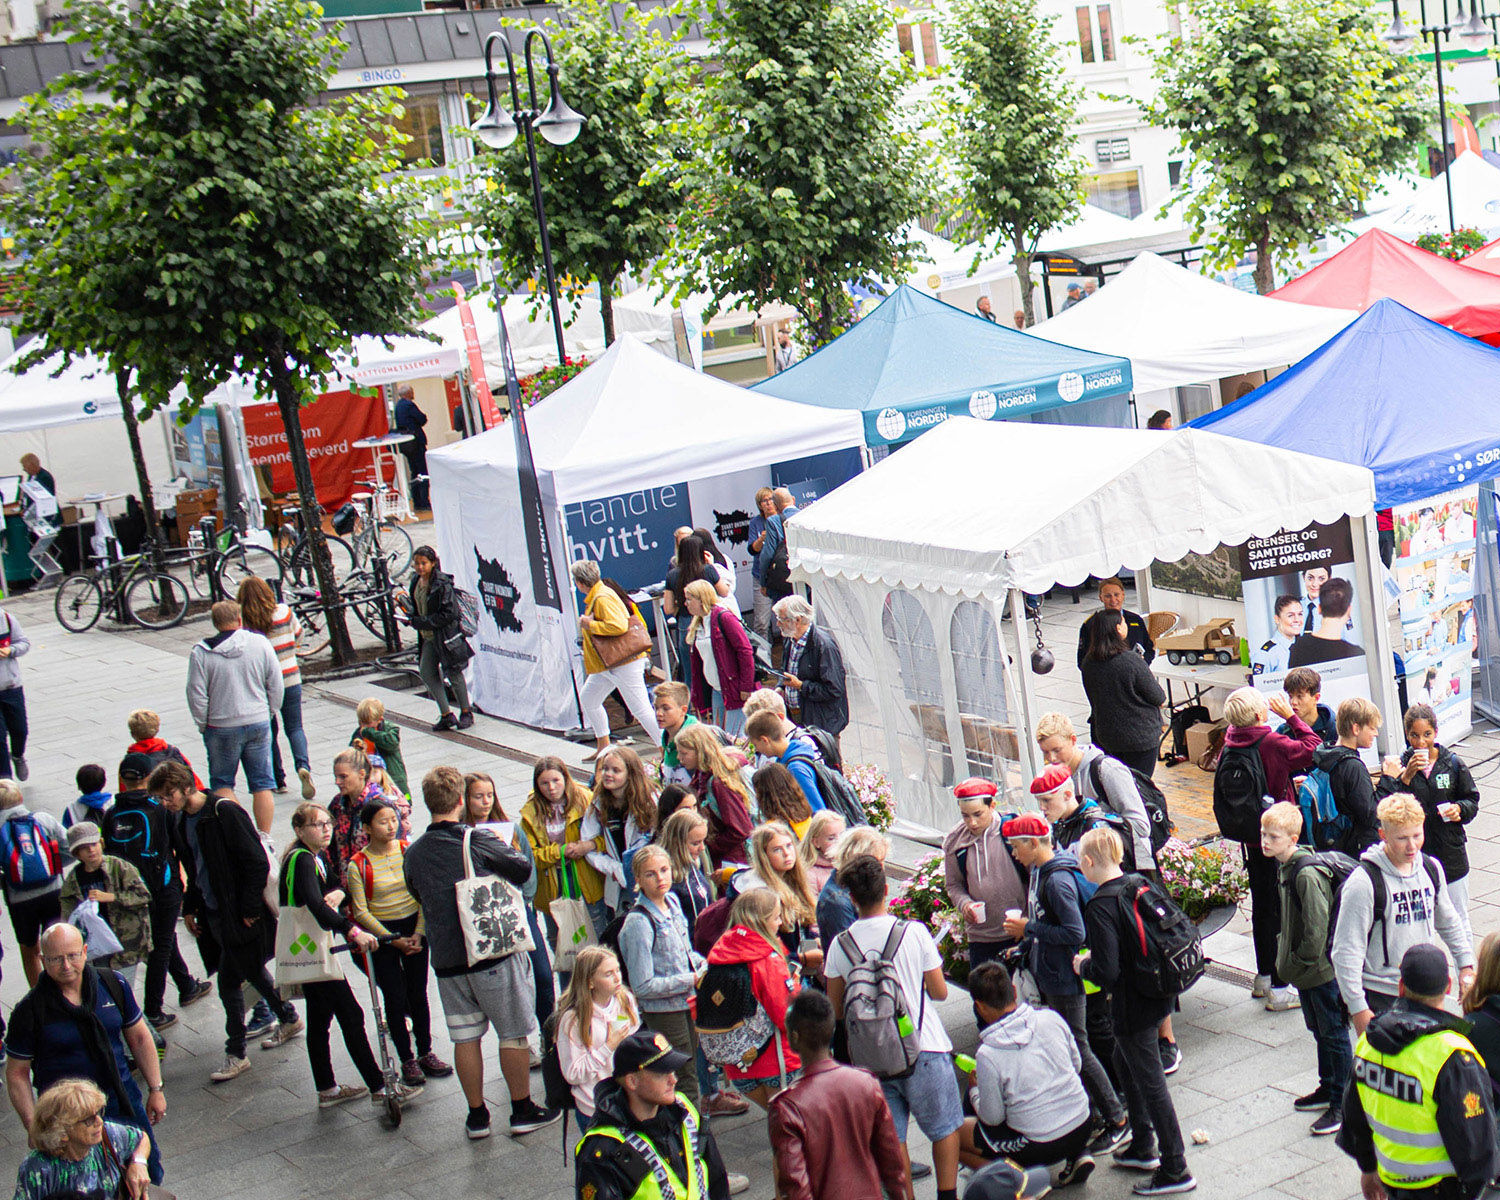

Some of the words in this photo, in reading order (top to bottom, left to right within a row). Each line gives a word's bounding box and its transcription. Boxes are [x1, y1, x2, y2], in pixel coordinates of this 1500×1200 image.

[362, 69, 401, 82] BINGO
[1086, 368, 1122, 382] FORENINGEN
[1086, 375, 1122, 391] NORDEN
[997, 387, 1037, 401] FORENINGEN
[999, 393, 1037, 410] NORDEN
[906, 405, 947, 419] FORENINGEN
[908, 412, 948, 429] NORDEN
[246, 432, 288, 449] Større
[564, 486, 677, 529] Handle
[568, 523, 659, 562] hvitt.
[1248, 533, 1300, 550] GRENSER
[1302, 530, 1318, 541] OG
[1248, 543, 1306, 560] SAMTIDIG
[1250, 558, 1276, 570] VISE
[1280, 548, 1332, 566] OMSORG?
[1355, 1056, 1422, 1105] POLITI
